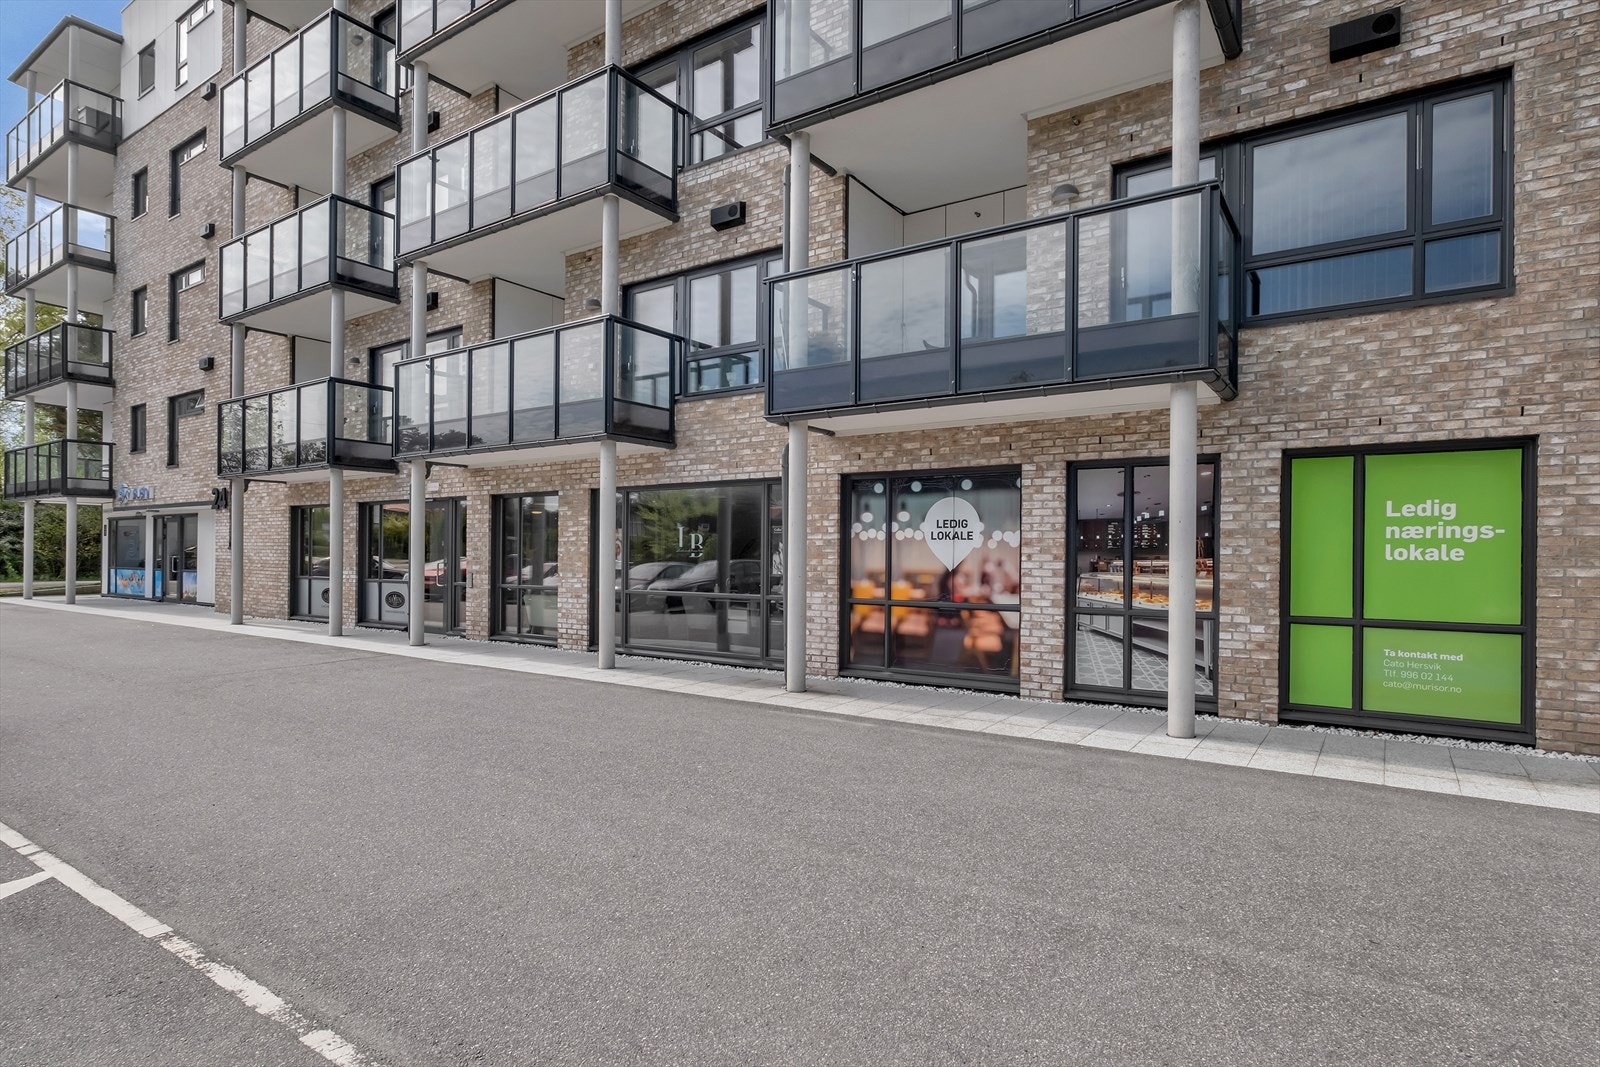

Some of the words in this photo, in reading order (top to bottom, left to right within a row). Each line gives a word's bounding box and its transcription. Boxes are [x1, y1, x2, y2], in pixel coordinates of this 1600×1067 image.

[1386, 499, 1456, 520] Ledig
[936, 519, 968, 529] LEDIG
[931, 531, 973, 541] LOKALE
[1385, 521, 1505, 543] nærings-
[1385, 544, 1464, 561] lokale
[1383, 649, 1395, 657] Ta
[1398, 650, 1437, 660] kontakt
[1440, 653, 1463, 661] med
[1383, 659, 1405, 668] Cato
[1407, 660, 1441, 670] Hersvik
[1384, 669, 1398, 677] Tlf.
[1400, 670, 1418, 679] 996
[1420, 672, 1433, 680] 02
[1436, 673, 1453, 681] 144
[1383, 681, 1462, 693] cato@murisor.no
